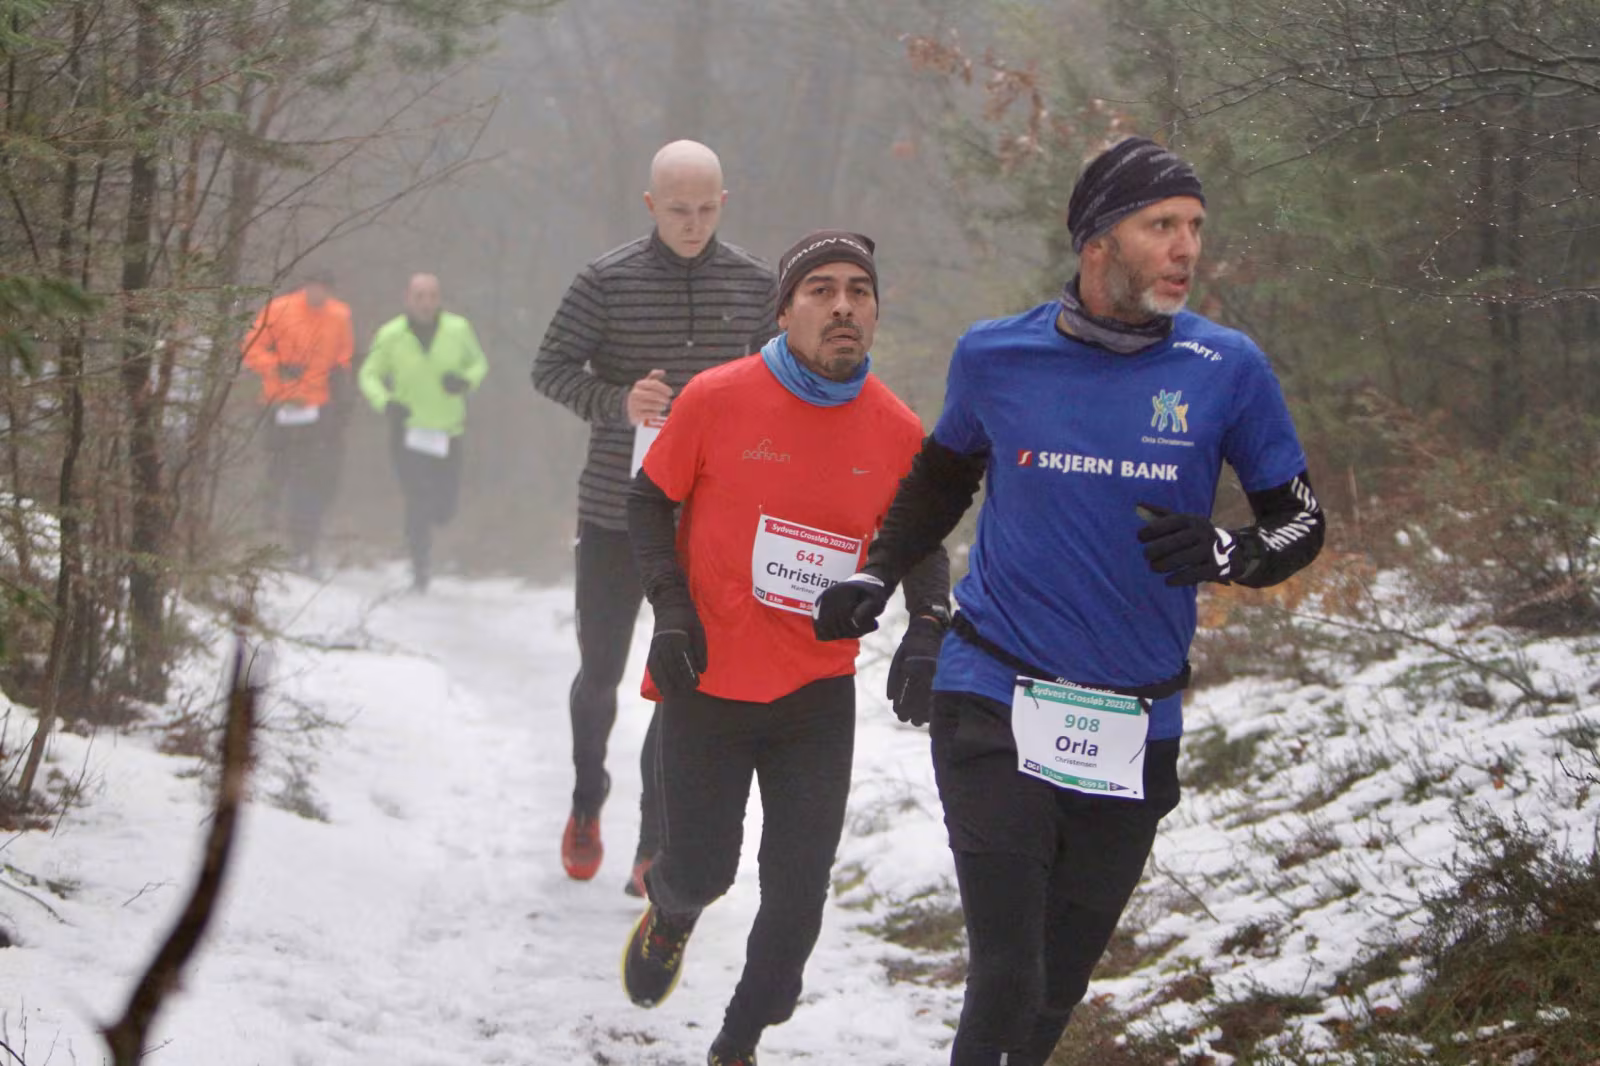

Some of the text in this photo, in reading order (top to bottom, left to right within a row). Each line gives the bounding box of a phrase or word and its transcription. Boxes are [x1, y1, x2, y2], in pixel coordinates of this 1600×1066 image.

[1038, 451, 1178, 481] SKJERN BANK
[772, 523, 856, 551] Sydvest Crossløb 2023/24
[796, 550, 824, 567] 642
[1032, 685, 1136, 711] Sydvest Crossløb 2023/24
[1064, 714, 1100, 733] 908
[1055, 736, 1098, 757] Orla
[1055, 756, 1098, 768] Christensen
